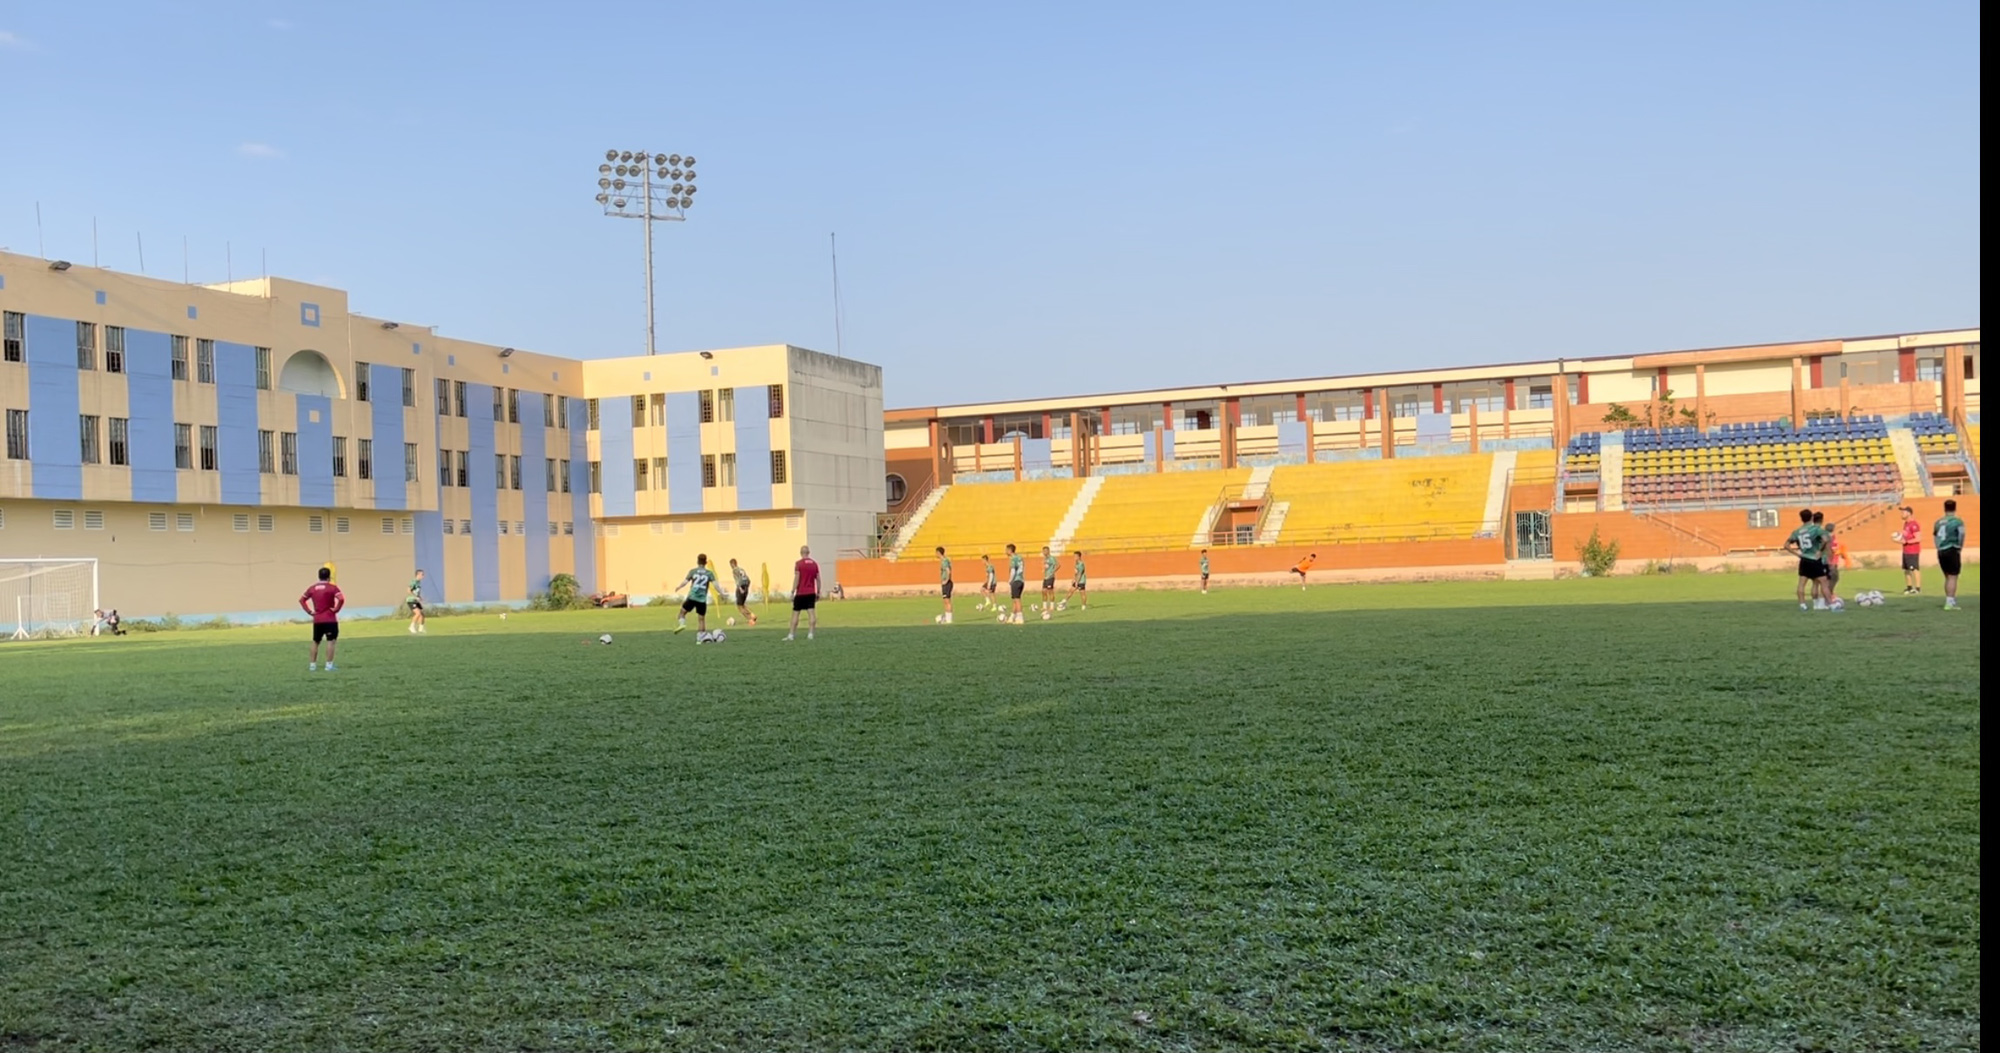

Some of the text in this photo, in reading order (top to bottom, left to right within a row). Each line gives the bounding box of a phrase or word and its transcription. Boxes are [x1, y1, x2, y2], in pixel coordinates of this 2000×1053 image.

[1798, 533, 1813, 549] 15
[1938, 525, 1947, 541] 4
[693, 574, 708, 589] 22
